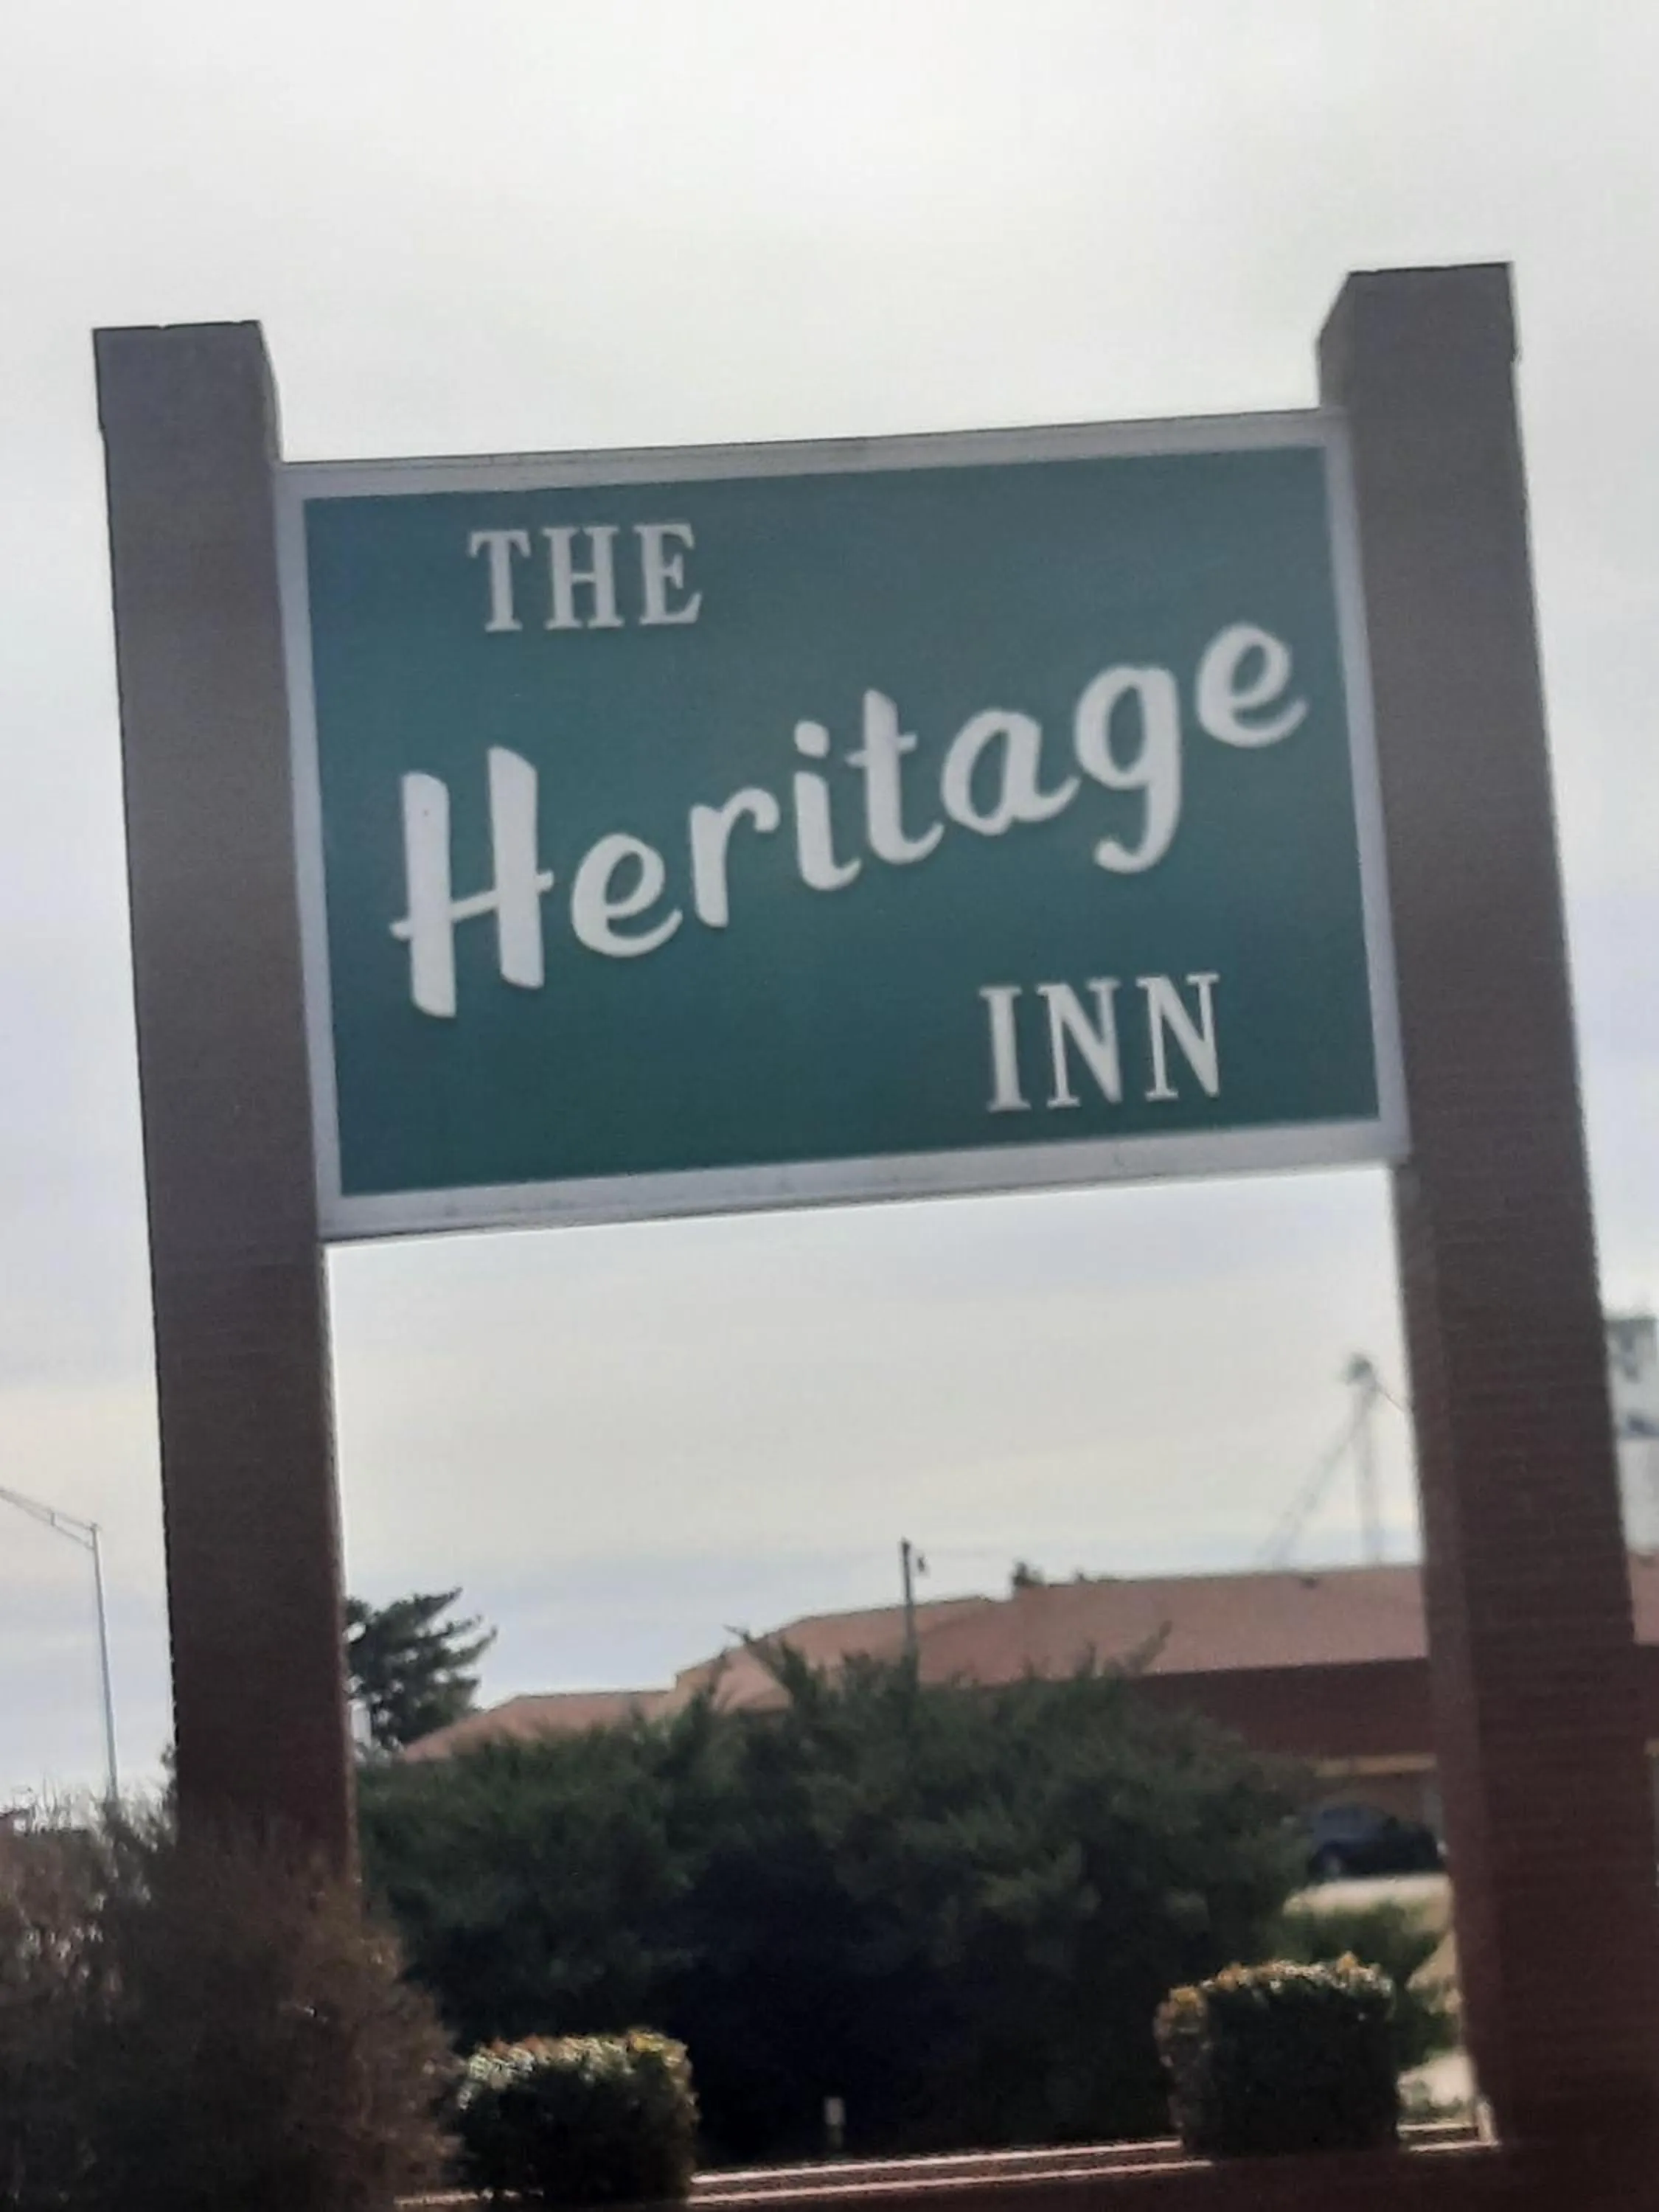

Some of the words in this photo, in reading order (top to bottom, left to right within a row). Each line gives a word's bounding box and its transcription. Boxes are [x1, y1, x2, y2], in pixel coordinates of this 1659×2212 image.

[467, 522, 703, 633] THE
[389, 621, 1310, 1017] Heritage
[978, 973, 1220, 1111] INN
